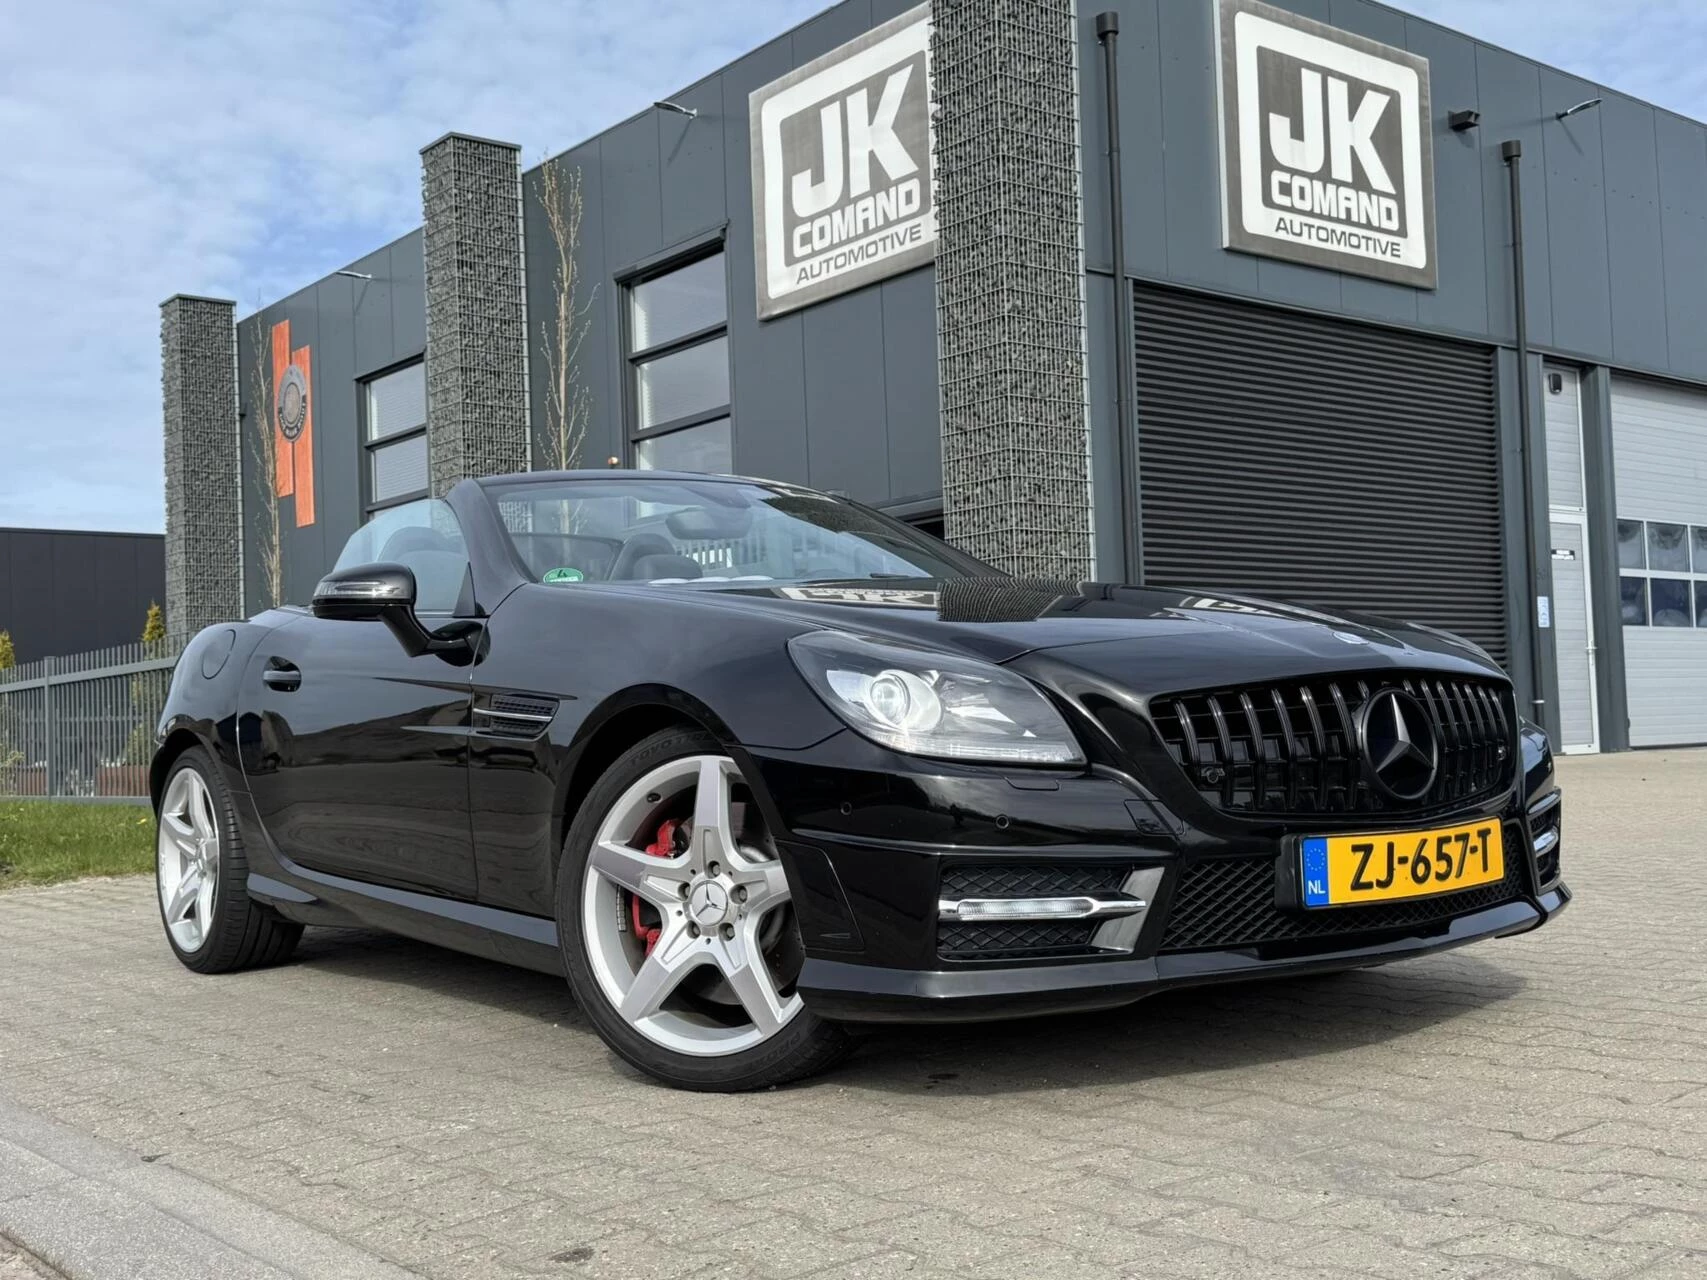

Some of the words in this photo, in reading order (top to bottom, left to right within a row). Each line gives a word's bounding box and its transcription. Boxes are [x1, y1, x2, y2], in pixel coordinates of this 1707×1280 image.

[791, 64, 919, 218] JK
[1269, 67, 1397, 195] JK
[793, 177, 920, 258] COMAND
[1270, 169, 1400, 232] COMAND
[796, 223, 922, 285] AUTOMOTIVE
[1275, 216, 1401, 259] AUTOMOTIVE
[1308, 879, 1326, 895] NL
[1350, 828, 1492, 892] ZJ-657-T
